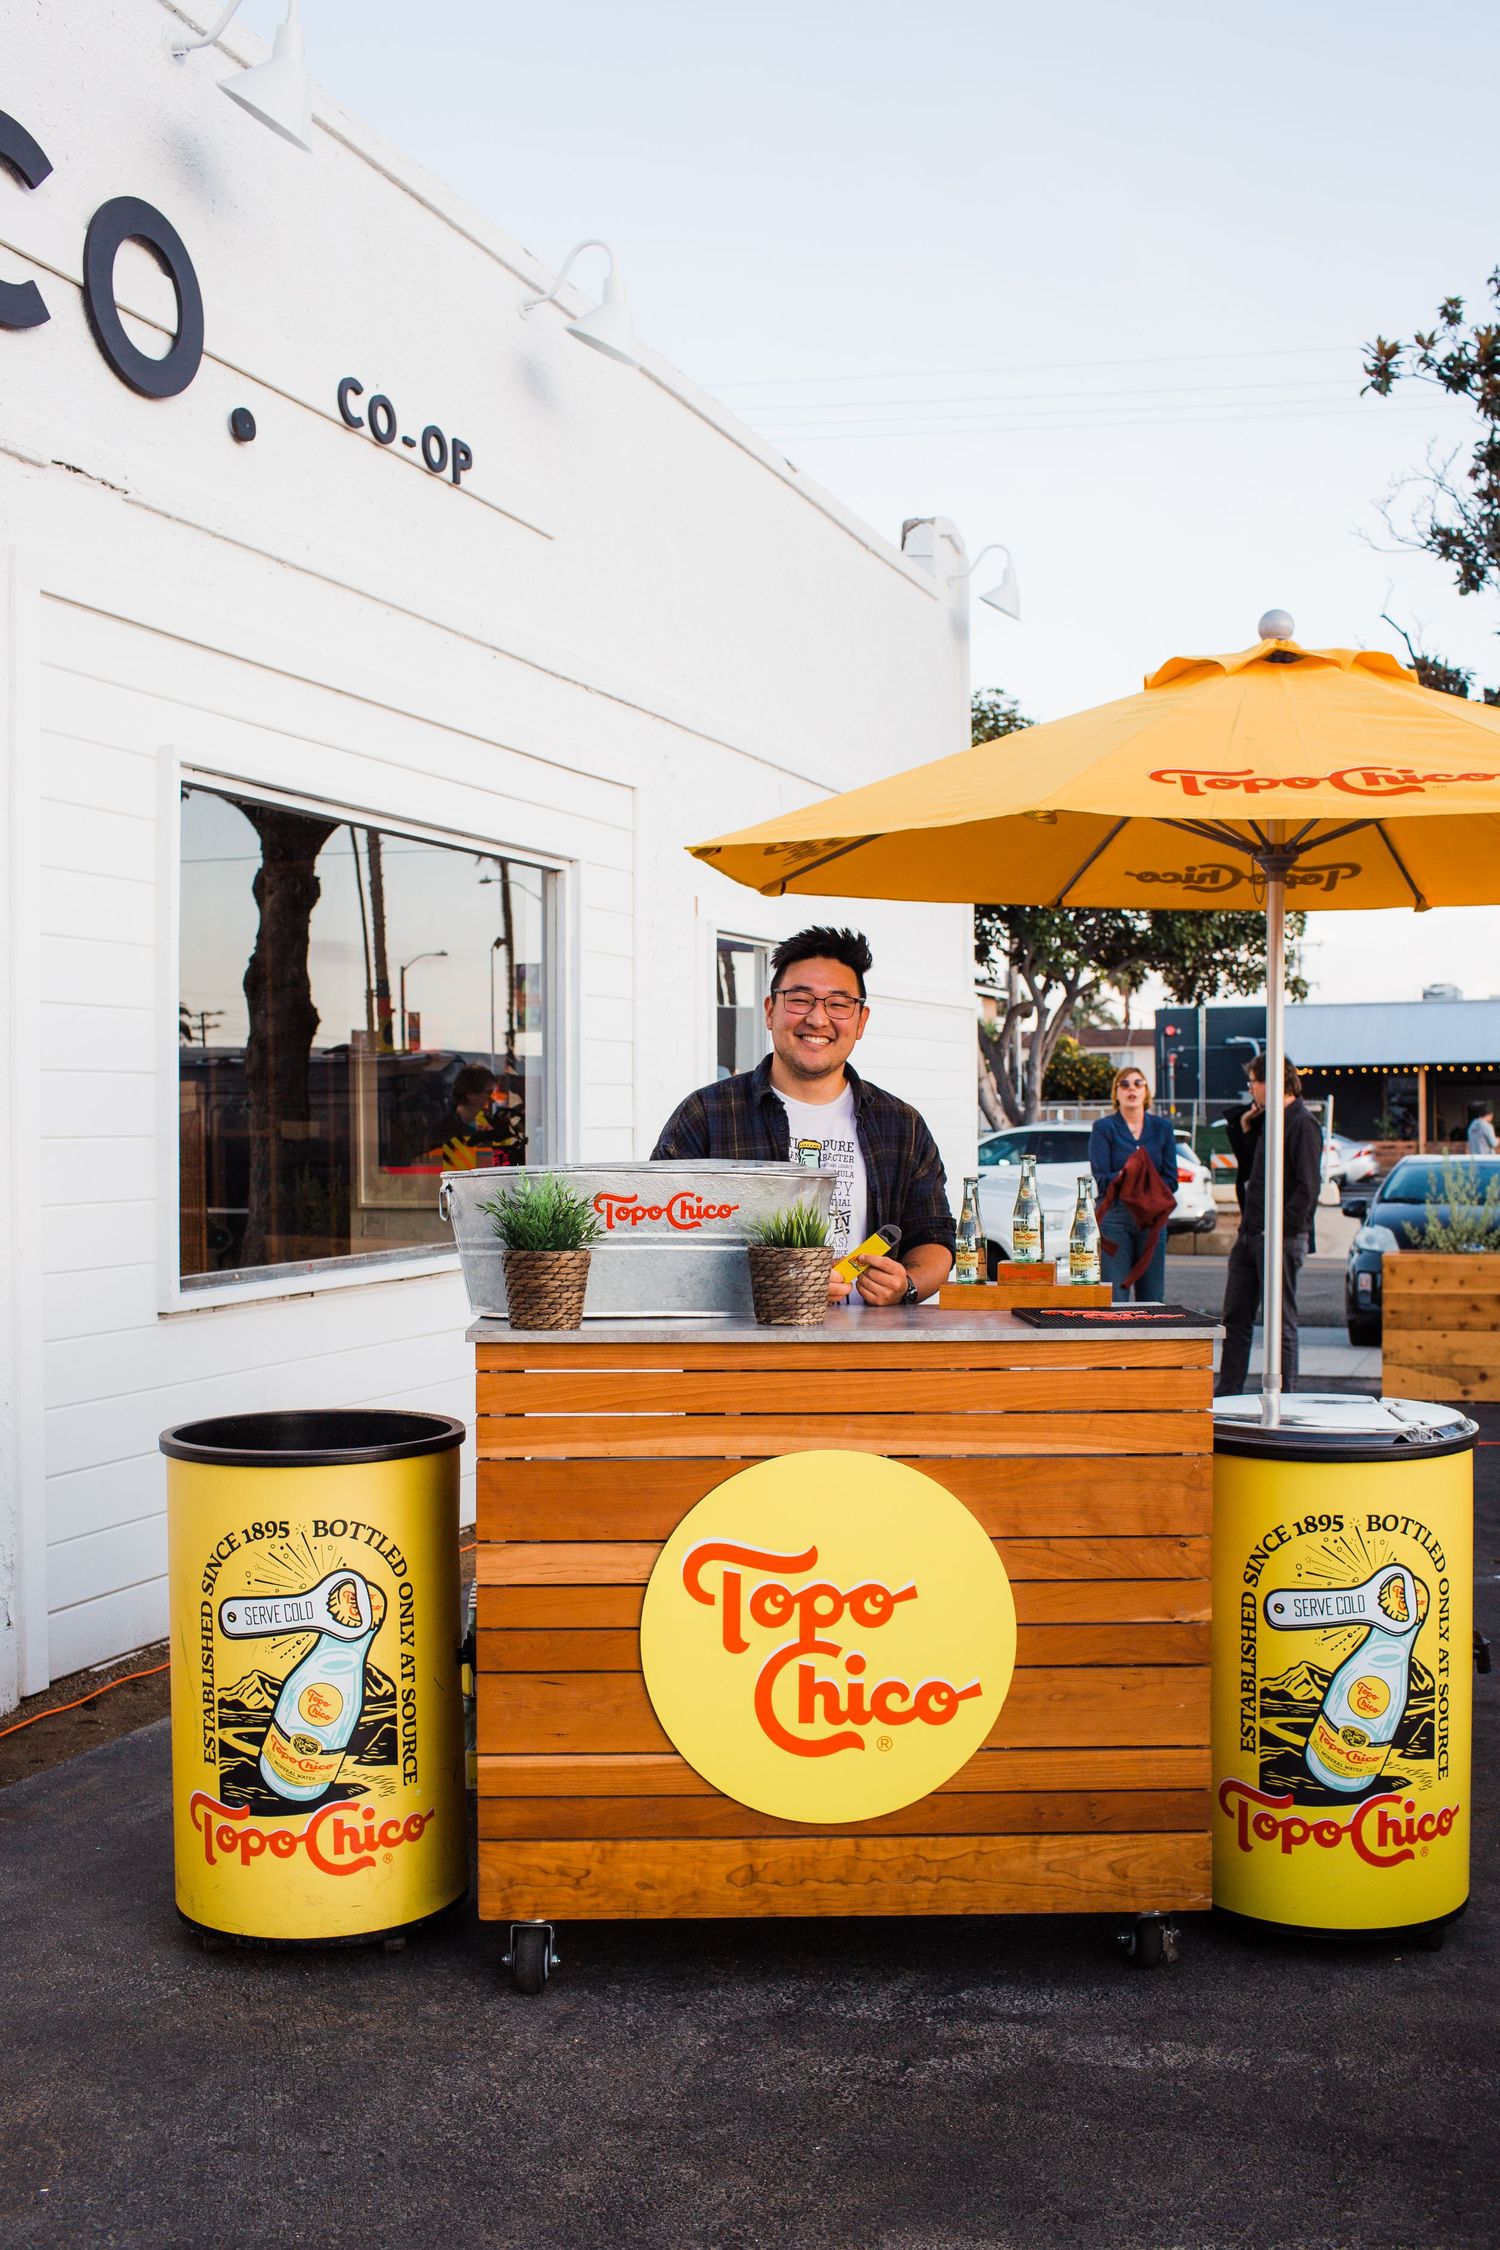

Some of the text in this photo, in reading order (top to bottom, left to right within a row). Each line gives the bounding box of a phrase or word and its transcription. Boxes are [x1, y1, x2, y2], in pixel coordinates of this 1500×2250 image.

[337, 377, 473, 485] CO-OP
[1148, 766, 1500, 797] Topo Chico
[822, 1139, 854, 1153] PURE
[593, 1191, 740, 1230] Topo Chico
[312, 1519, 408, 1578] BOTTLED
[1366, 1514, 1446, 1573] BOTTLED
[244, 1601, 314, 1626] SERVE COLD
[398, 1582, 415, 1647] ONLY
[681, 1537, 918, 1654] Topo
[1293, 1594, 1366, 1618] SERVE COLD
[1438, 1577, 1450, 1642] ONLY
[200, 1521, 290, 1766] ESTABLISHED SINCE 1895
[1240, 1514, 1344, 1755] ESTABLISHED SINCE 1895
[400, 1652, 416, 1683] AT
[1438, 1648, 1450, 1677] AT
[307, 1689, 331, 1708] Topo
[307, 1705, 334, 1721] Chico
[754, 1637, 983, 1758] Chico
[1356, 1681, 1380, 1701] Topo
[1356, 1697, 1381, 1714] Chico
[270, 1733, 300, 1766] Topo
[298, 1758, 338, 1773] Chico
[401, 1689, 418, 1786] SOURCE
[1318, 1725, 1346, 1755] Topo
[1344, 1750, 1384, 1765] Chico
[1437, 1685, 1449, 1781] SOURCE
[190, 1789, 435, 1876] Topo Chico
[1218, 1777, 1460, 1868] Topo Chico
